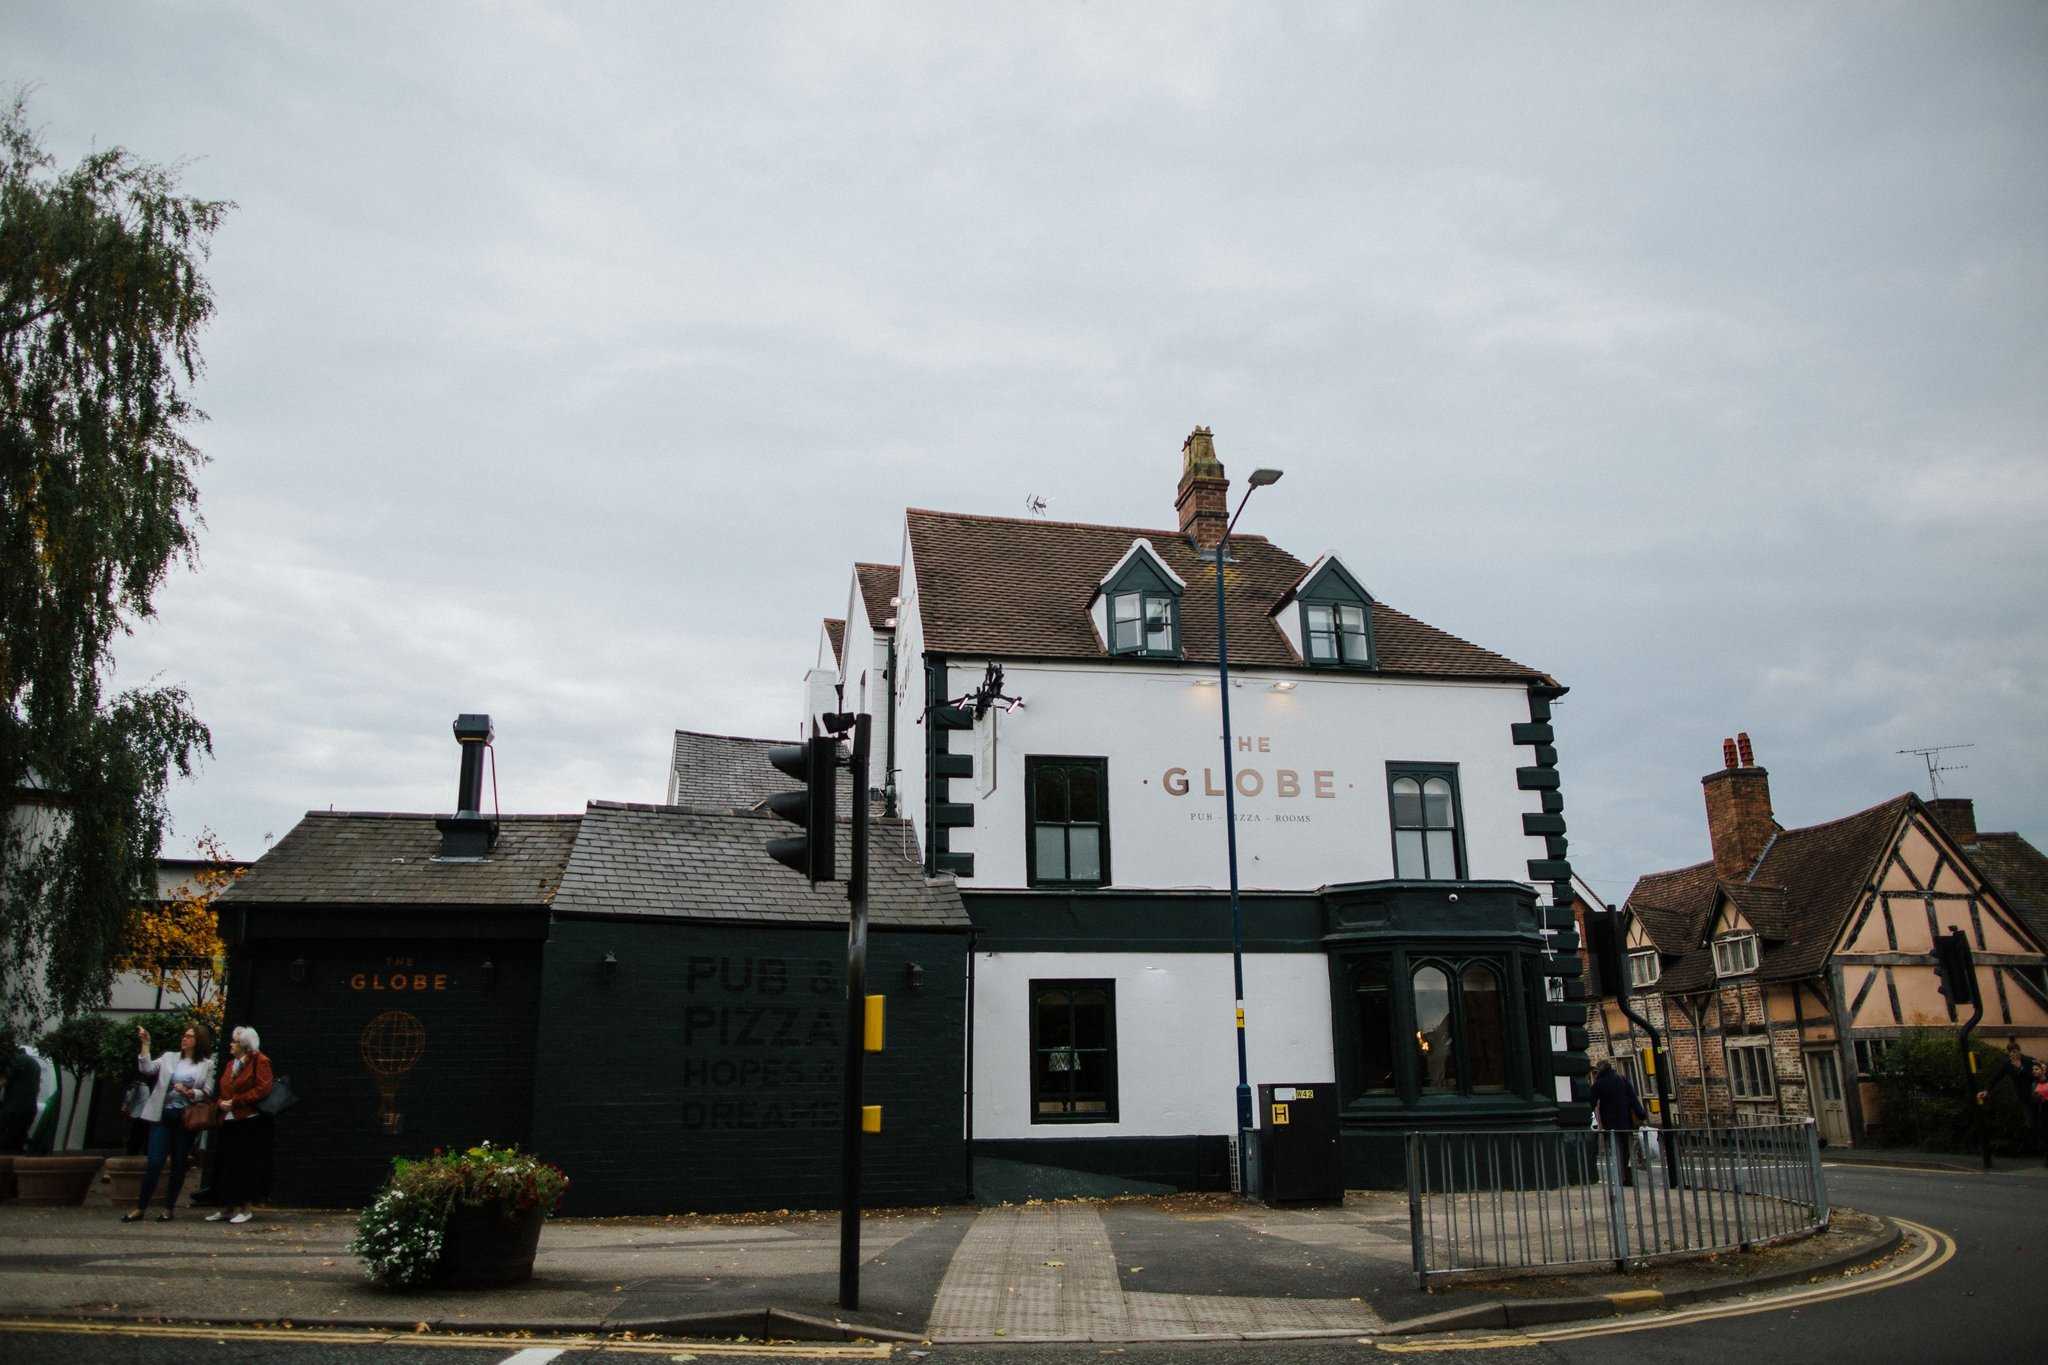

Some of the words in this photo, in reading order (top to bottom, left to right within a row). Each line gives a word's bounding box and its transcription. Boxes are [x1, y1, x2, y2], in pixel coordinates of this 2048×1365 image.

[1162, 767, 1336, 799] GLOBE
[1190, 812, 1213, 822] PUB
[1275, 814, 1312, 824] ROOMS
[351, 973, 448, 991] GLOBE
[686, 956, 788, 995] PUB
[684, 1005, 839, 1046] PIZZA
[683, 1057, 805, 1088] HOPES
[681, 1100, 840, 1130] DREAMS
[1274, 1106, 1287, 1122] H
